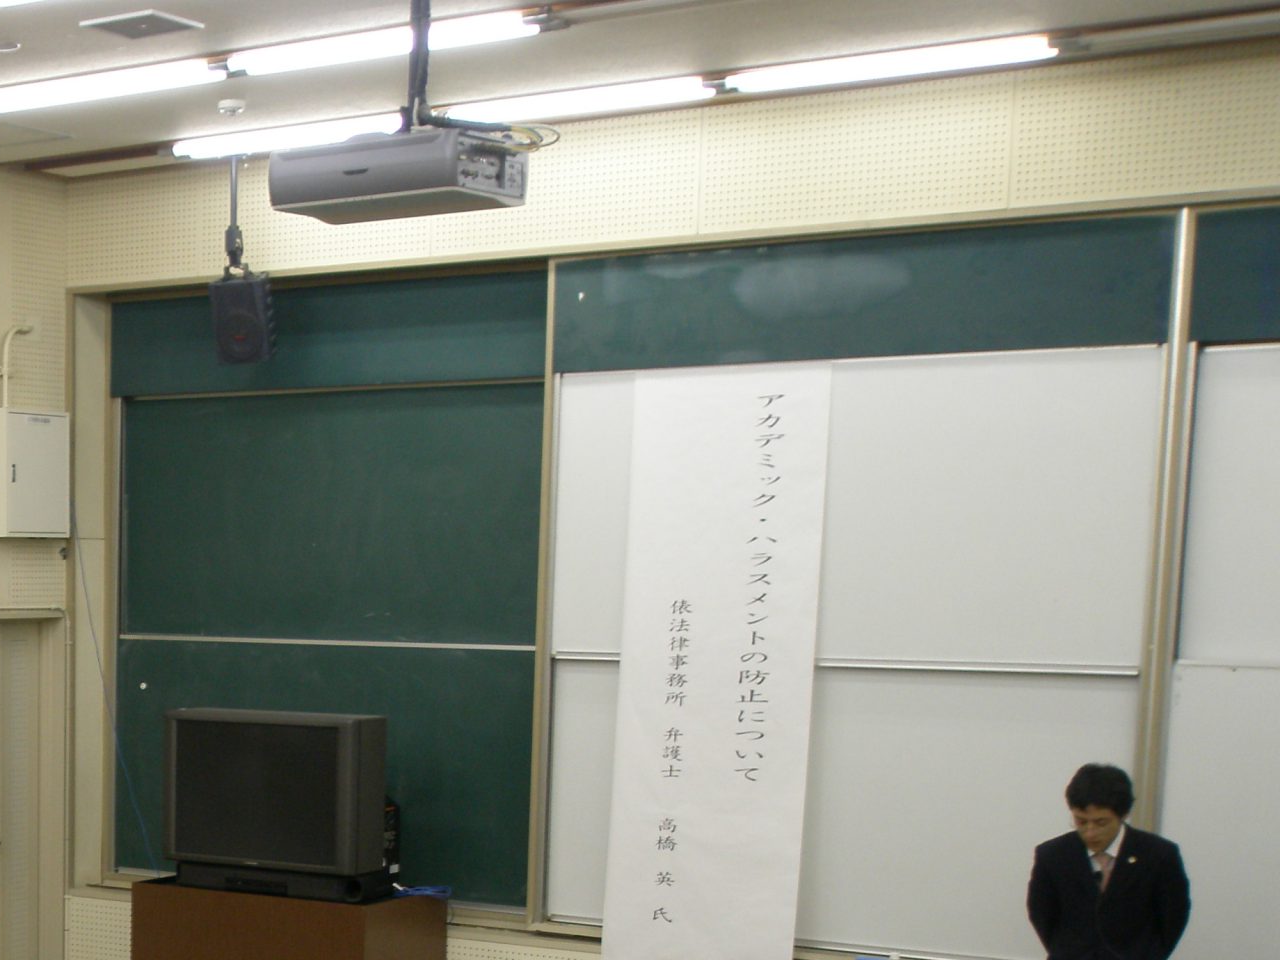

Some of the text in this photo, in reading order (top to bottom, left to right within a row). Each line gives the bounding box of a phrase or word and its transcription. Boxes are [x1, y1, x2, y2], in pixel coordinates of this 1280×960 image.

[733, 393, 786, 782] アカデミック・ハラスメントの防止について
[660, 726, 685, 779] 弁護士
[652, 906, 673, 924] 氏
